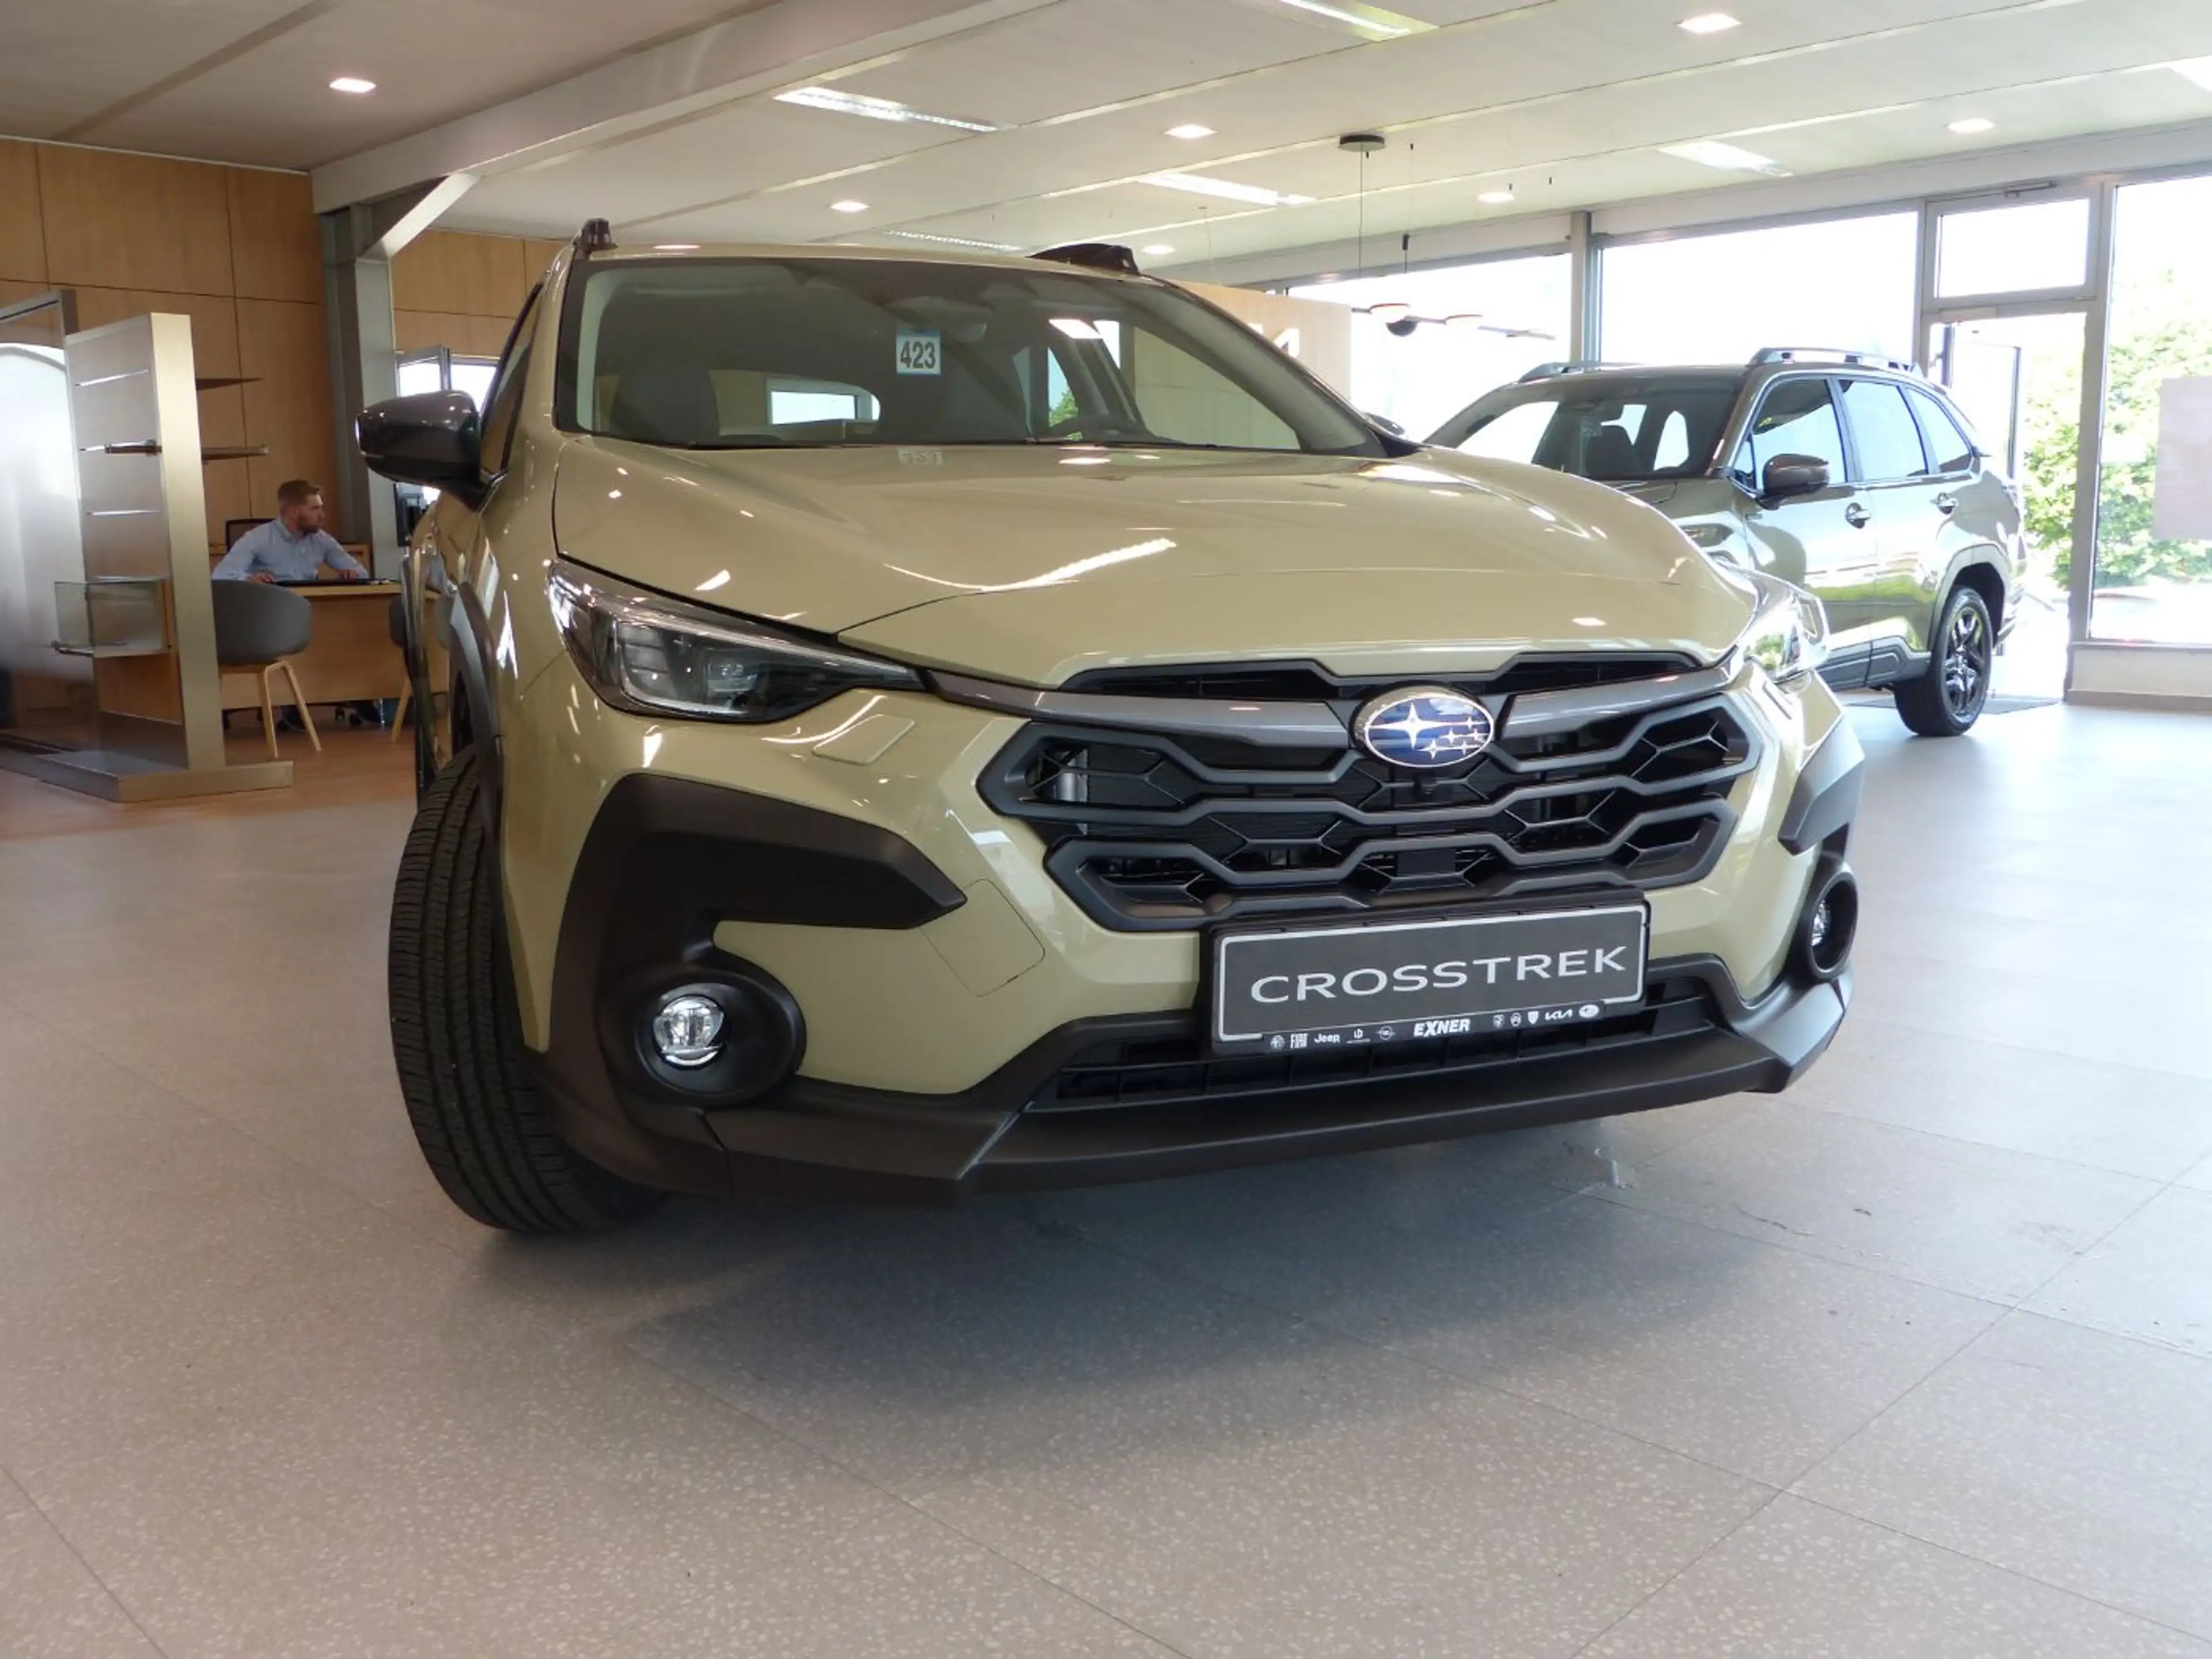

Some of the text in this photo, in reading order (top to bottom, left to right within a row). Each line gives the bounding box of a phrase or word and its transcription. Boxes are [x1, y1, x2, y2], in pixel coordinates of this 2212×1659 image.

[900, 341, 936, 369] 423
[1250, 945, 1628, 1004] CROSSTREK
[1314, 1033, 1341, 1044] Jeep
[1413, 1018, 1471, 1037] EXNER
